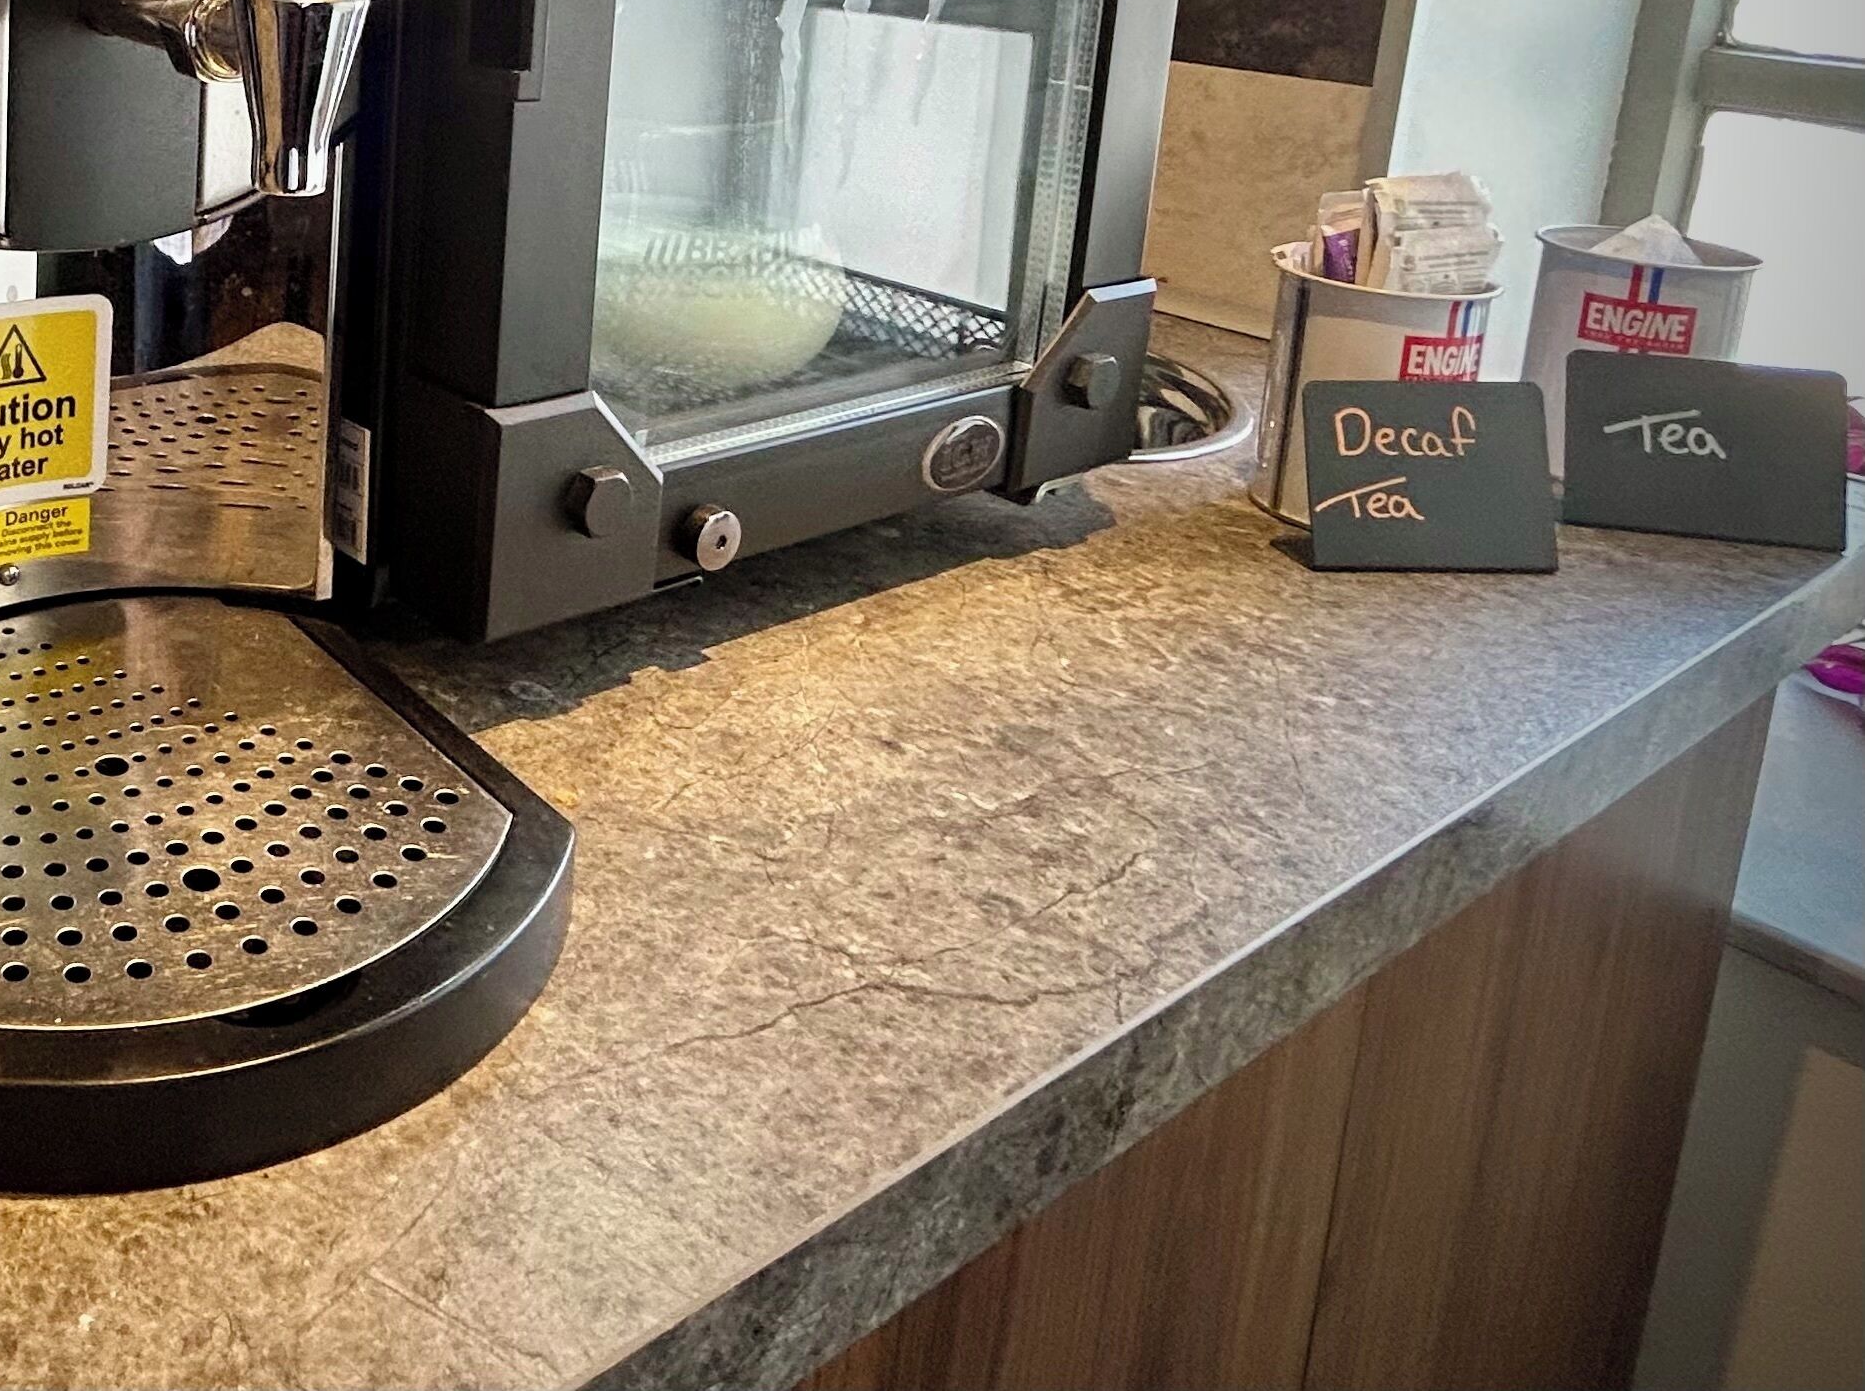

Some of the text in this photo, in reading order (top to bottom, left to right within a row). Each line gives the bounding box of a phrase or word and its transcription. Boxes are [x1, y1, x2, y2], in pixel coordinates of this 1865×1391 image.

[1586, 302, 1689, 343] ENGINE
[1407, 342, 1480, 376] ENGINE
[20, 424, 64, 450] hot
[1334, 406, 1476, 460] Decaf
[1603, 409, 1726, 460] Tea
[5, 506, 68, 526] Danger
[1315, 476, 1425, 520] Tea
